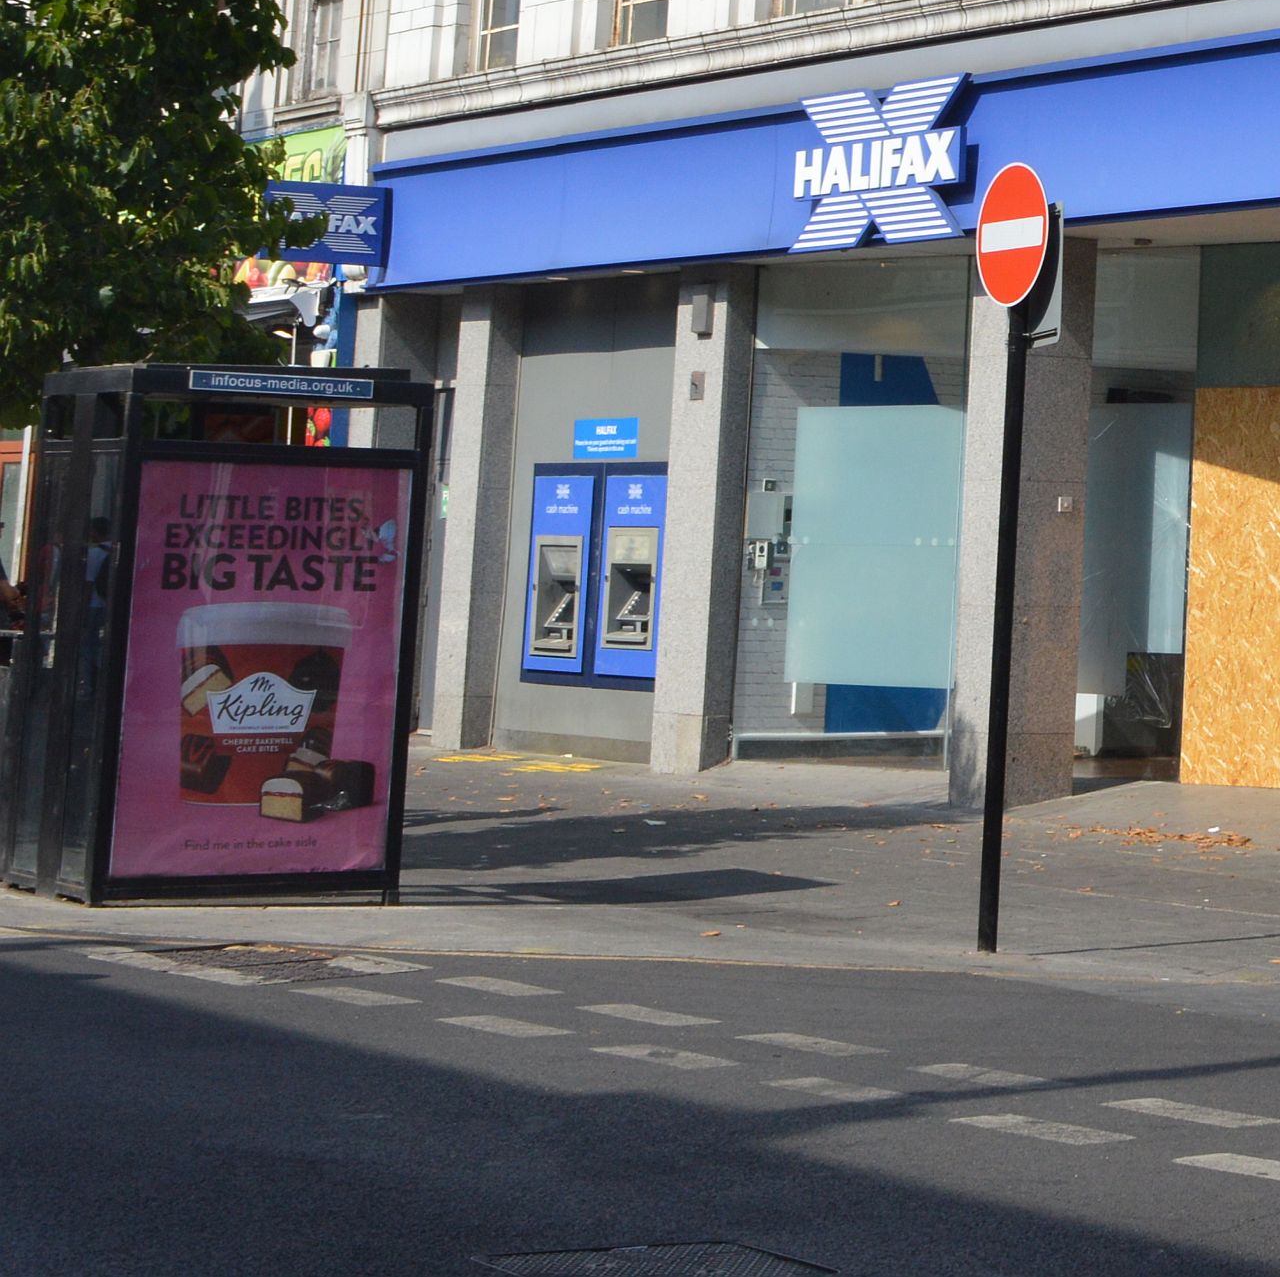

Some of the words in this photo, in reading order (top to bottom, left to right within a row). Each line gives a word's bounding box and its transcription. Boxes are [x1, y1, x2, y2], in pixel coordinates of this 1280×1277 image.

[793, 130, 957, 199] HALIFAX
[211, 374, 353, 394] infocus-media.org.uk
[180, 493, 275, 520] LITTLE
[161, 553, 237, 591] BIG
[247, 554, 379, 592] TASTE
[250, 676, 275, 692] Mr
[217, 693, 304, 725] Kipling
[222, 738, 253, 746] CHERRY
[255, 737, 293, 745] BAKEWELL
[236, 745, 257, 753] CAKE
[258, 744, 279, 752] BITES
[184, 839, 209, 850] Find
[213, 841, 230, 850] me
[233, 839, 243, 849] in
[247, 837, 264, 849] the
[267, 837, 292, 848] cake
[295, 836, 317, 848] aisle
